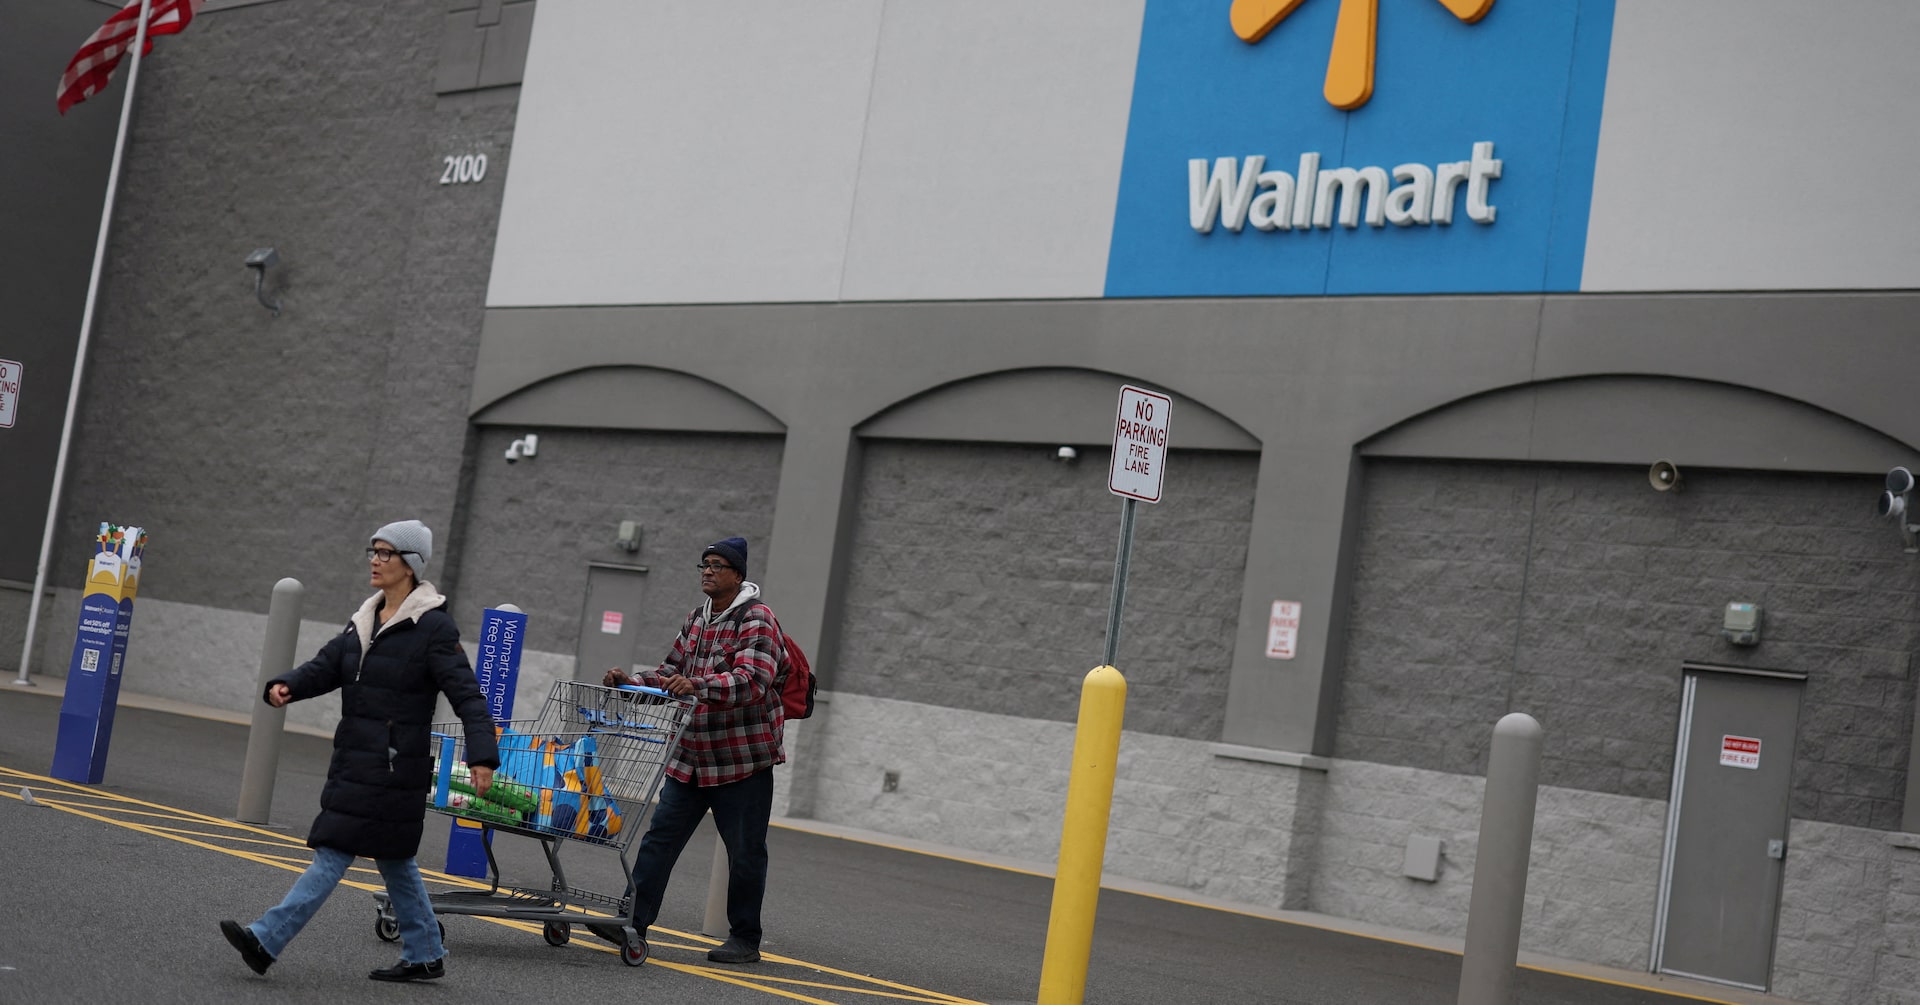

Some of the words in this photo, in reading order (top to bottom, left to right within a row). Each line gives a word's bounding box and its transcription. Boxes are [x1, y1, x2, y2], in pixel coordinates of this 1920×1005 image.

[439, 153, 488, 184] 2100
[1188, 141, 1503, 233] Walmart
[1135, 400, 1154, 422] NO
[1119, 419, 1165, 447] PARKING
[1129, 443, 1150, 460] FIRE
[1124, 457, 1150, 476] LANE
[487, 617, 503, 643] free
[499, 620, 519, 680] Walmart+
